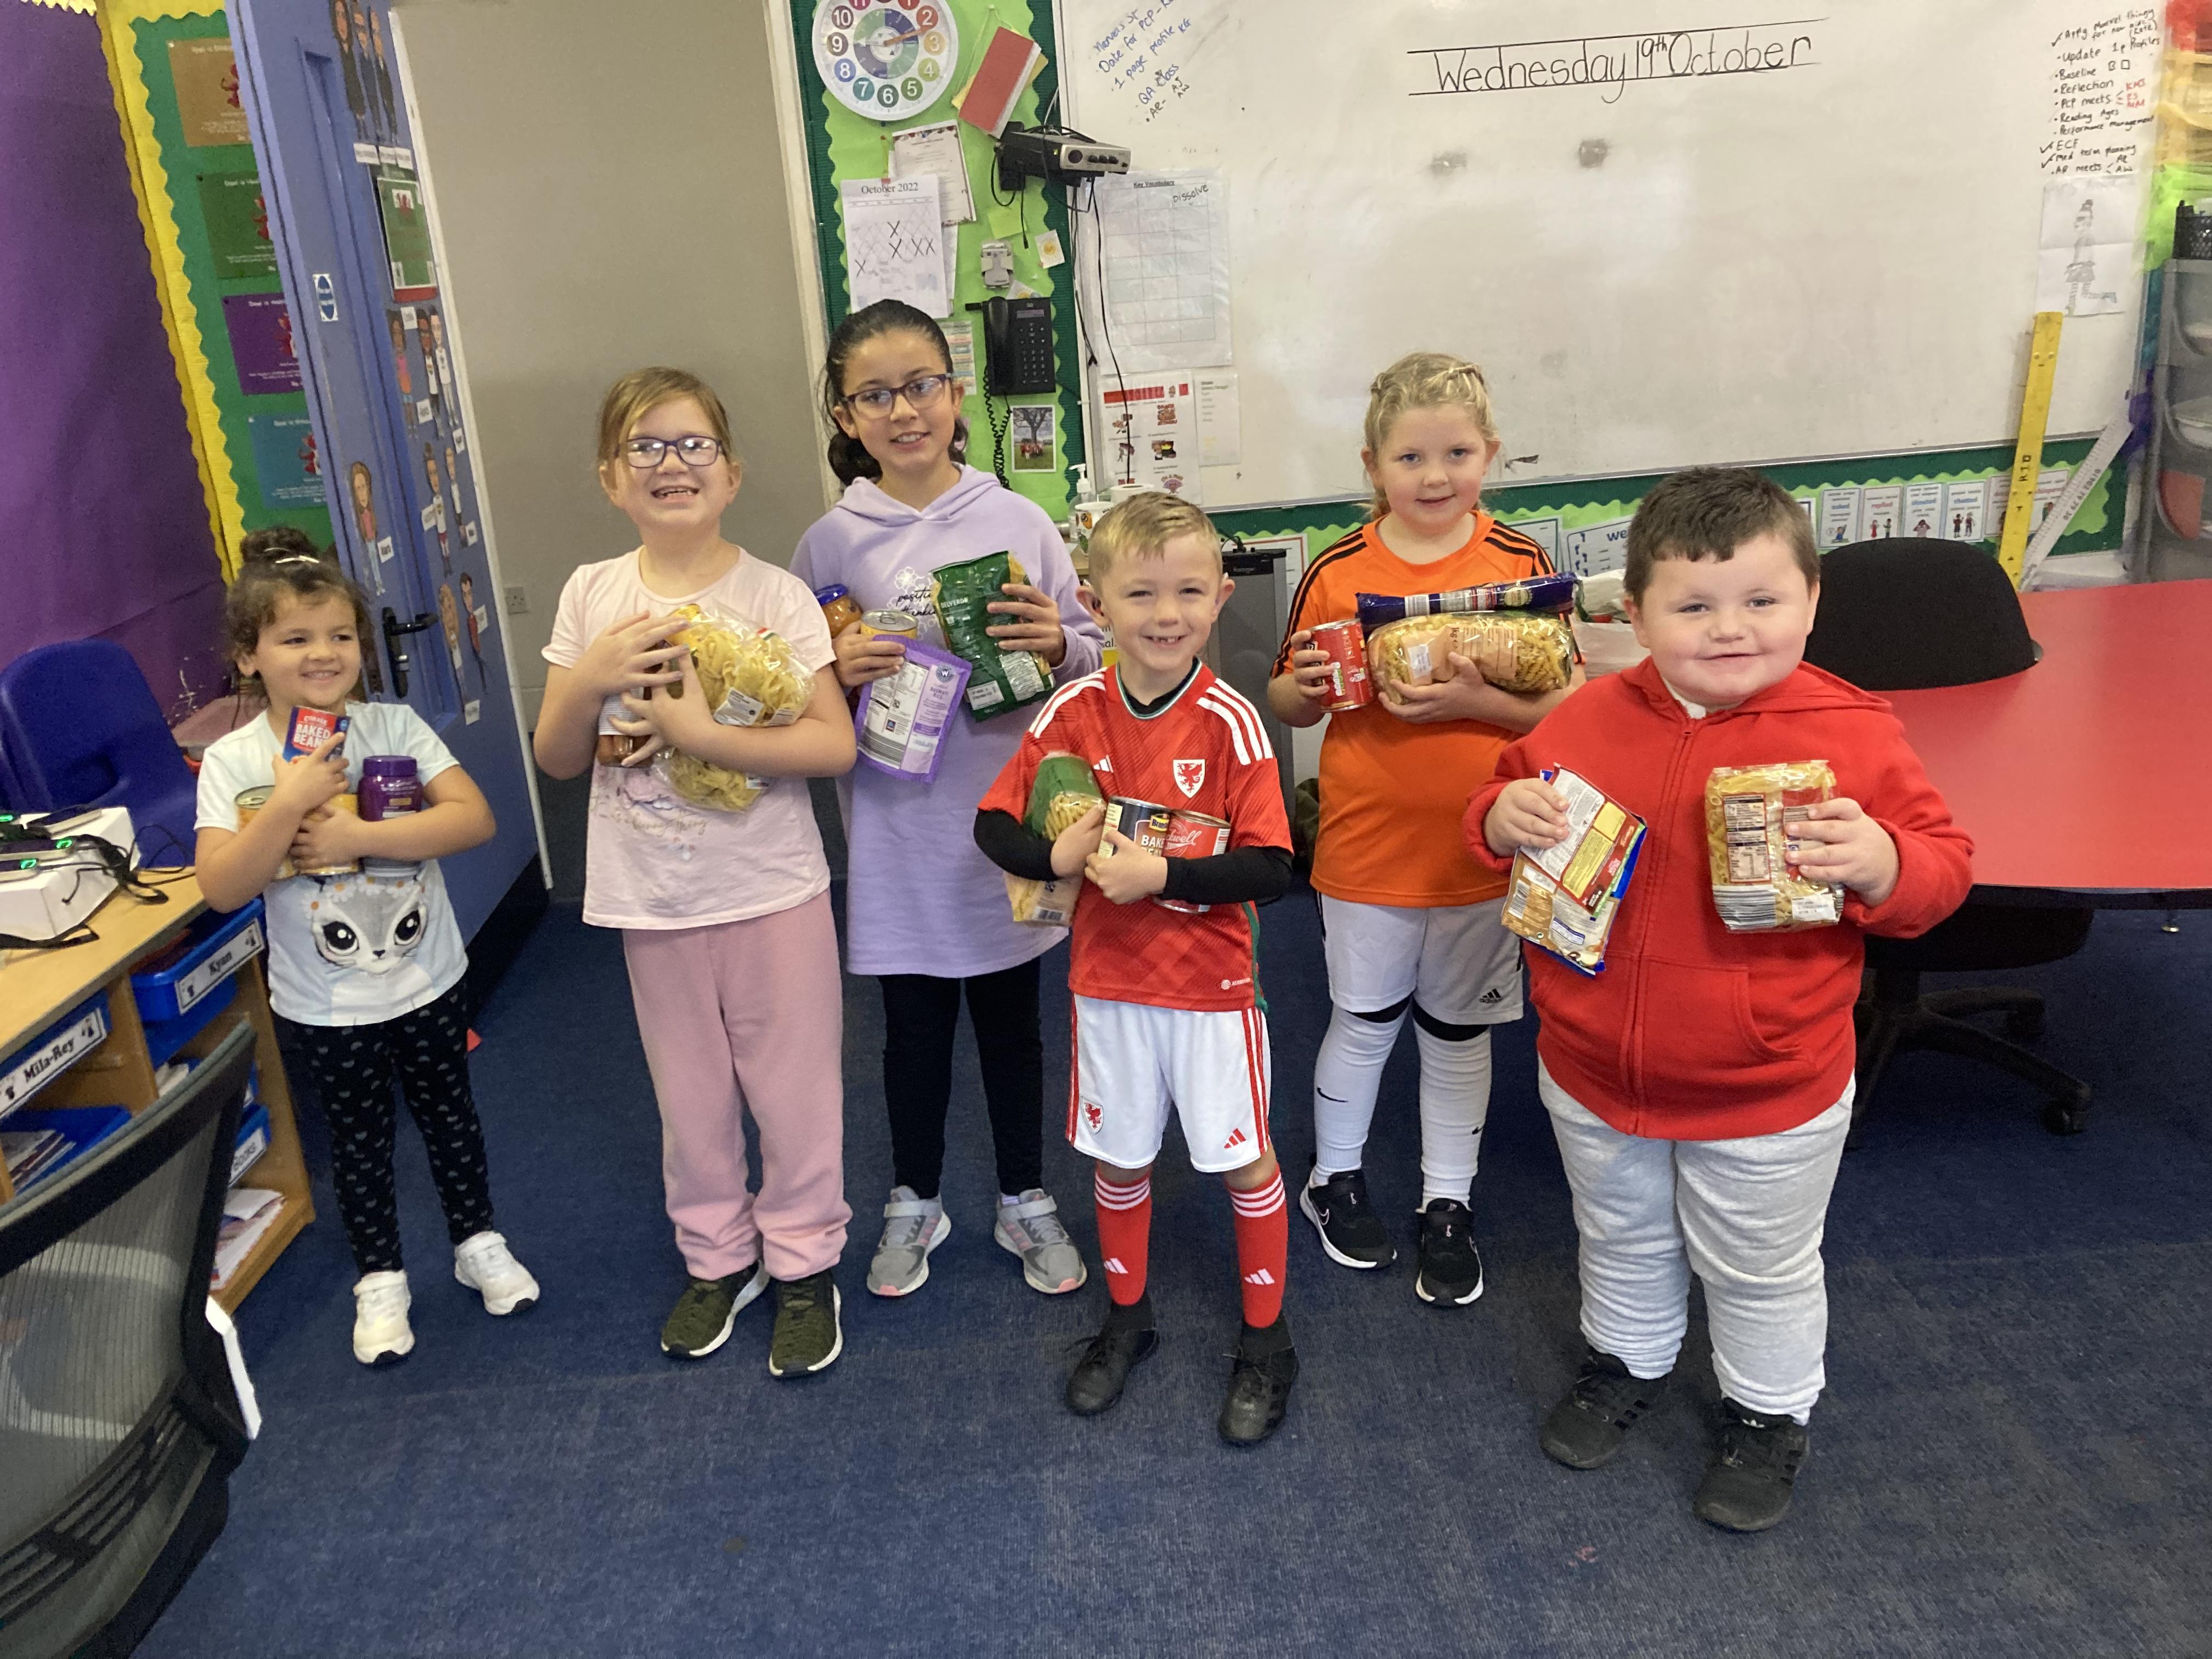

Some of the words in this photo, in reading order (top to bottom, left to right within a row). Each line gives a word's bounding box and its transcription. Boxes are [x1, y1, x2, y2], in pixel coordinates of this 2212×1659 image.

[833, 9, 851, 26] 10
[922, 9, 933, 26] 2
[832, 36, 842, 52] 9
[930, 36, 939, 52] 3
[1099, 50, 1124, 73] Date
[1124, 33, 1137, 50] for
[1126, 55, 1148, 80] page
[1150, 26, 1175, 57] profile
[2063, 48, 2101, 65] Update
[840, 62, 850, 78] 8
[923, 62, 934, 77] 4
[1434, 39, 1627, 103] Wednesday
[1636, 37, 1668, 79] 19th
[1668, 30, 1812, 77] October
[2059, 68, 2096, 80] Baseline
[858, 81, 869, 97] 7
[907, 81, 917, 96] 5
[2061, 80, 2113, 94] Reflection
[883, 88, 893, 104] 6
[1138, 87, 1156, 104] QA
[2082, 94, 2112, 105] meets
[2060, 112, 2092, 123] Reading
[2056, 139, 2079, 151] ECF
[861, 184, 895, 194] October
[898, 183, 919, 192] 2022
[296, 724, 331, 740] BAKED
[294, 733, 323, 748] BEAN
[1141, 835, 1164, 848] BAKE
[24, 1037, 75, 1082] Mila-Rey
